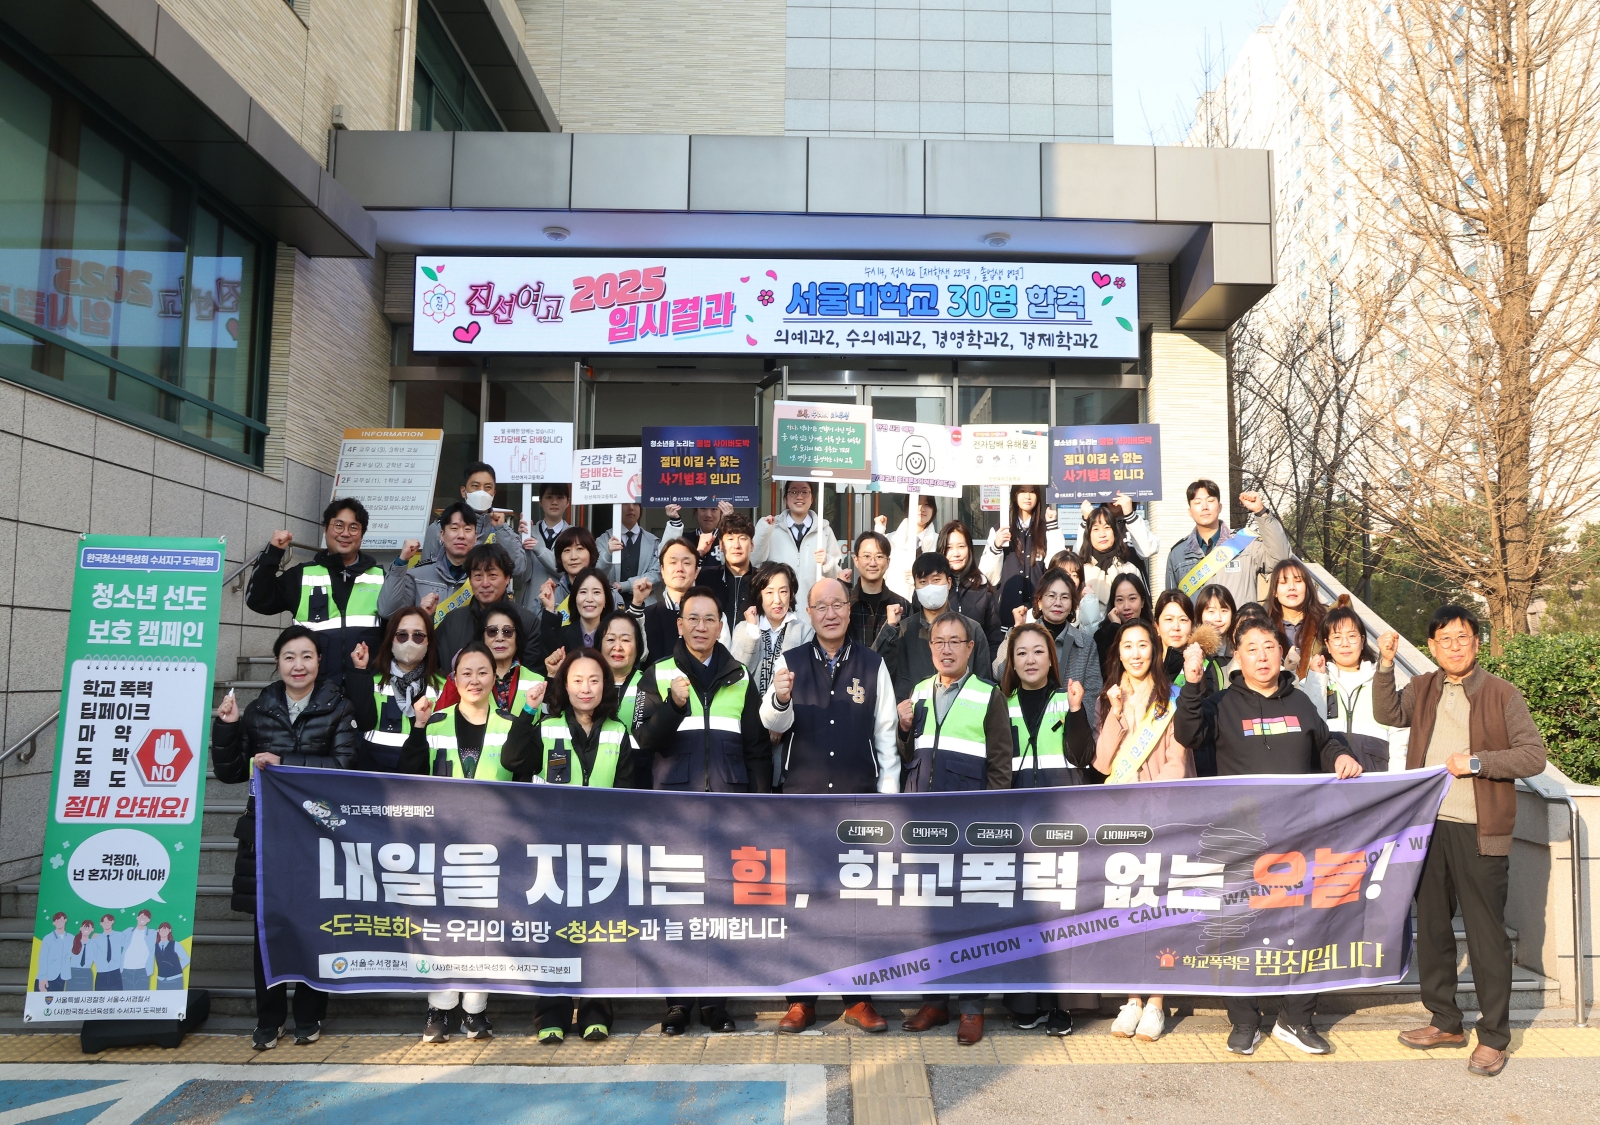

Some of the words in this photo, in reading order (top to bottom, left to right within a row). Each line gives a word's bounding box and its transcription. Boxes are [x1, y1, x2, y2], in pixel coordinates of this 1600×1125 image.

[570, 266, 667, 312] 2025
[466, 281, 565, 325] 진선여고
[785, 281, 940, 317] 서울대학교
[946, 284, 1019, 318] 30명
[1025, 284, 1086, 319] 합격
[608, 292, 735, 344] 입시결과
[773, 328, 840, 349] 의예과2,
[846, 329, 926, 349] 수의예과2,
[931, 330, 1014, 350] 경영학과2,
[1020, 330, 1099, 350] 경제학과2
[493, 435, 527, 444] 전자담배도
[529, 435, 563, 444] 담배입니다
[650, 440, 675, 448] 청소년을
[676, 440, 695, 448] 노리는
[696, 439, 711, 448] 불법
[713, 439, 750, 448] 사이버도박
[973, 440, 1004, 450] 전자담배
[1006, 439, 1037, 450] 유해물질
[1053, 438, 1078, 447] 청소년을
[1079, 438, 1098, 446] 노리는
[1115, 436, 1153, 445] 사이버도박
[580, 455, 613, 466] 건강한
[615, 453, 638, 465] 학교
[660, 456, 681, 468] 절대
[683, 456, 704, 468] 이길
[706, 456, 717, 468] 수
[719, 456, 740, 468] 없는
[1063, 453, 1084, 466] 절대
[1087, 453, 1107, 465] 이길
[1109, 453, 1120, 465] 수
[1122, 452, 1143, 464] 없는
[580, 467, 623, 479] 담배없는
[659, 472, 707, 486] 사기범죄
[710, 473, 741, 485] 입니다
[1063, 469, 1111, 483] 사기범죄
[1113, 469, 1145, 481] 입니다
[579, 480, 602, 491] 학교
[86, 553, 149, 565] 한국청소년육성회
[150, 556, 182, 566] 수서지구
[182, 556, 214, 567] 도곡분회
[91, 582, 158, 610] 청소년
[163, 585, 207, 611] 선도
[87, 619, 133, 645] 보호
[138, 621, 204, 647] 캠페인
[82, 679, 116, 698] 학교
[119, 680, 153, 698] 폭력
[80, 702, 151, 721] 딥페이크
[150, 766, 175, 781] NO
[63, 796, 111, 818] 절대
[114, 796, 189, 818] 안돼요!
[340, 804, 435, 818] 학교폭력예방캠페인
[848, 825, 884, 837] 신체폭력
[912, 827, 948, 838] 언어폭력
[976, 828, 1013, 840] 금품갈취
[1045, 829, 1073, 841] 따돌림
[1102, 829, 1147, 840] 사이버폭력
[102, 853, 140, 867] 걱정마,
[73, 869, 85, 881] 넌
[87, 869, 124, 881] 혼자가
[126, 868, 166, 881] 아니야!
[319, 837, 500, 908] 내일을
[525, 843, 705, 908] 지키는
[730, 846, 810, 908] 힘,
[838, 850, 1080, 911] 학교폭력
[1102, 852, 1226, 911] 없는
[1249, 840, 1397, 910] 오늘!
[319, 914, 441, 942] <도곡분회>는
[446, 919, 505, 943] 우리의
[511, 920, 551, 944] 희망
[555, 918, 661, 944] <청소년>과
[664, 918, 684, 941] 늘
[688, 916, 788, 941] 함께합니다
[851, 958, 932, 986] WARNING
[949, 936, 1021, 964] CAUTION
[1039, 915, 1120, 944] WARNING
[350, 958, 408, 969] 서울수서경찰서
[1182, 954, 1250, 971] 학교폭력은
[1255, 941, 1385, 977] 범죄입니다
[432, 962, 507, 974] (사)한국청소년육성회
[509, 964, 539, 974] 수서지구
[540, 965, 571, 975] 도곡분회
[54, 996, 106, 1004] 서울특별시경찰청
[106, 995, 151, 1003] 서울수서경찰서
[53, 1007, 115, 1016] (사)한국청소년육성회
